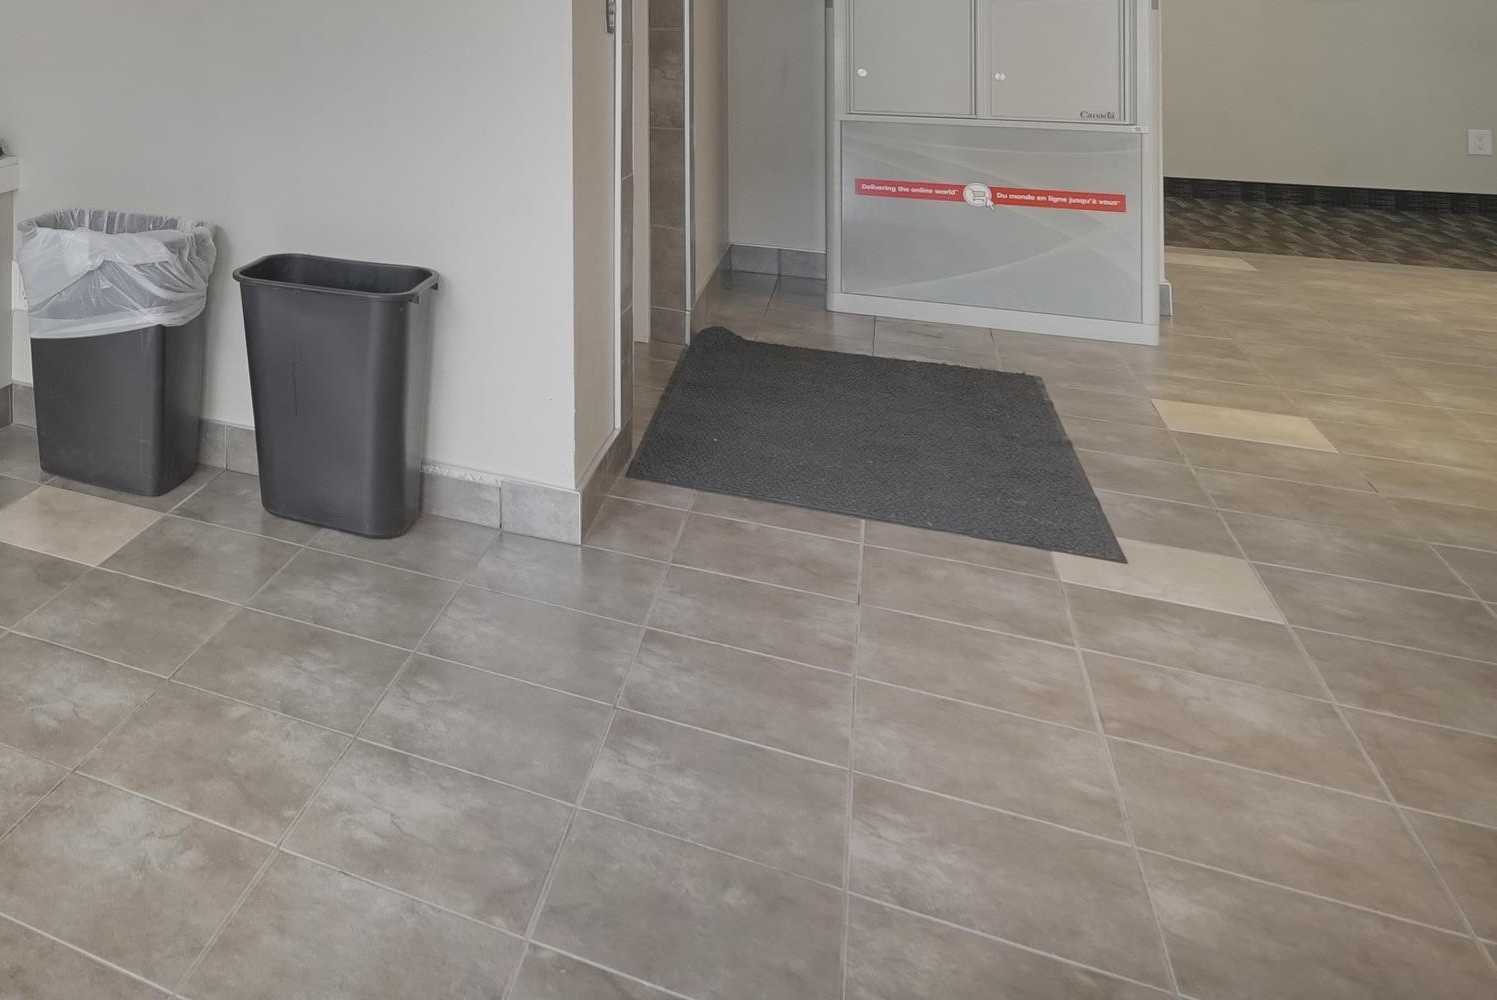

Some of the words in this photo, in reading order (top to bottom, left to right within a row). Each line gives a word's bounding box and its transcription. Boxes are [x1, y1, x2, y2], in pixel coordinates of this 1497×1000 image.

[861, 183, 896, 193] Delivering
[1009, 193, 1035, 201] monde
[1048, 195, 1067, 204] ligne
